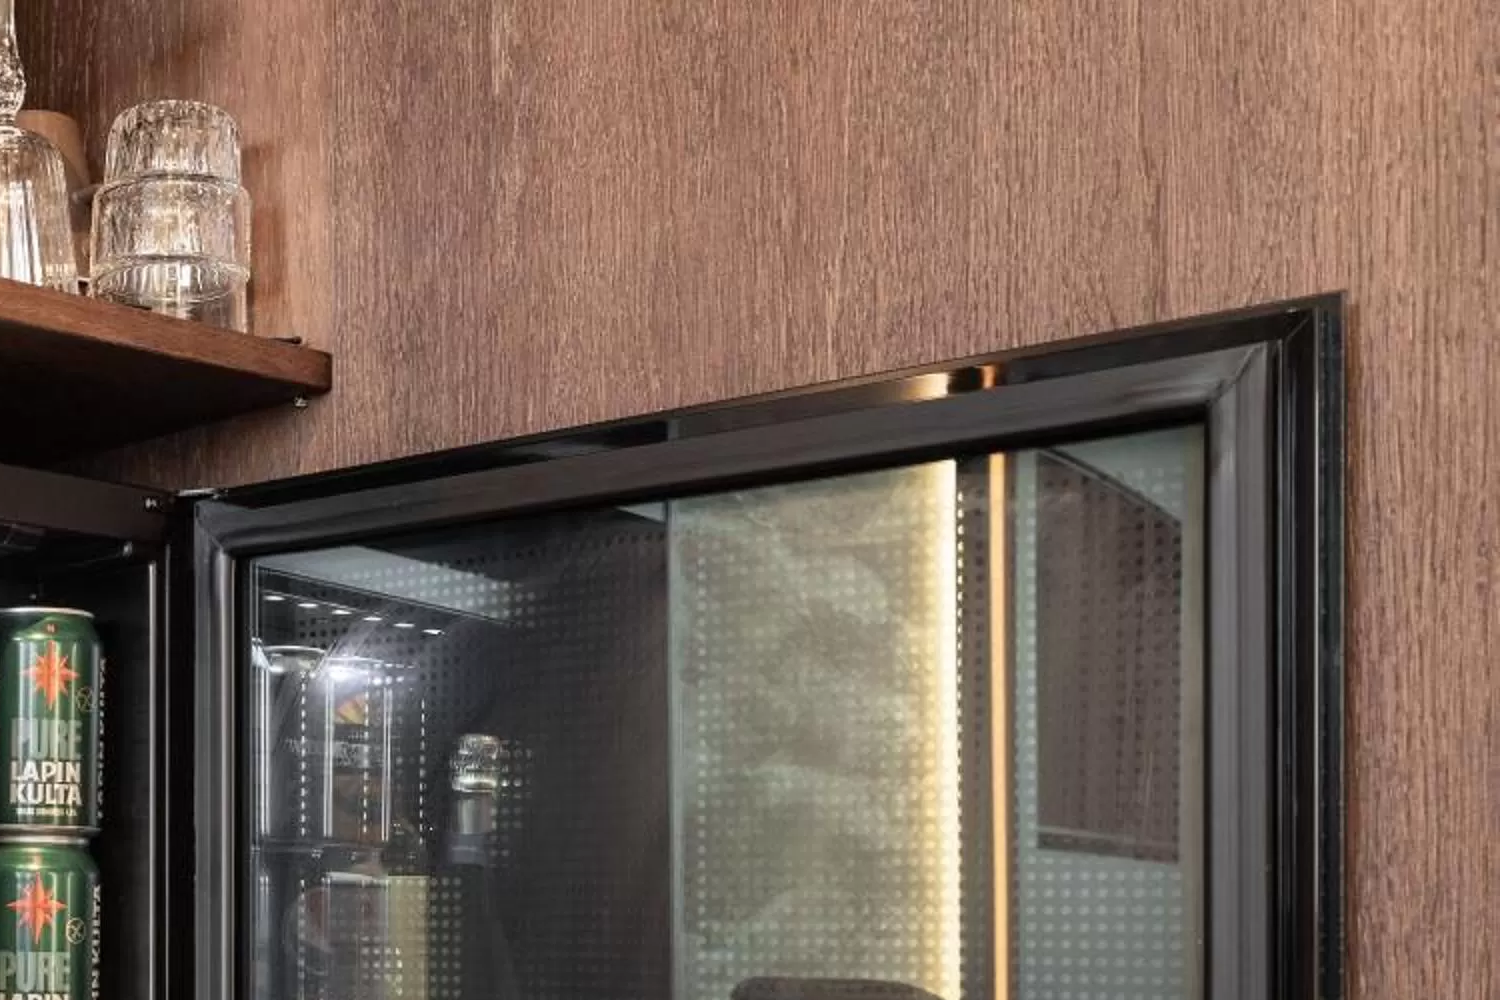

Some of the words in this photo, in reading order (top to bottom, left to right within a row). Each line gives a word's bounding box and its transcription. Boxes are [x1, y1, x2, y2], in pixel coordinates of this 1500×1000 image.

[11, 717, 82, 760] PURE
[11, 761, 81, 782] LAPIN
[10, 783, 82, 805] KULTA
[0, 951, 71, 992] PURE
